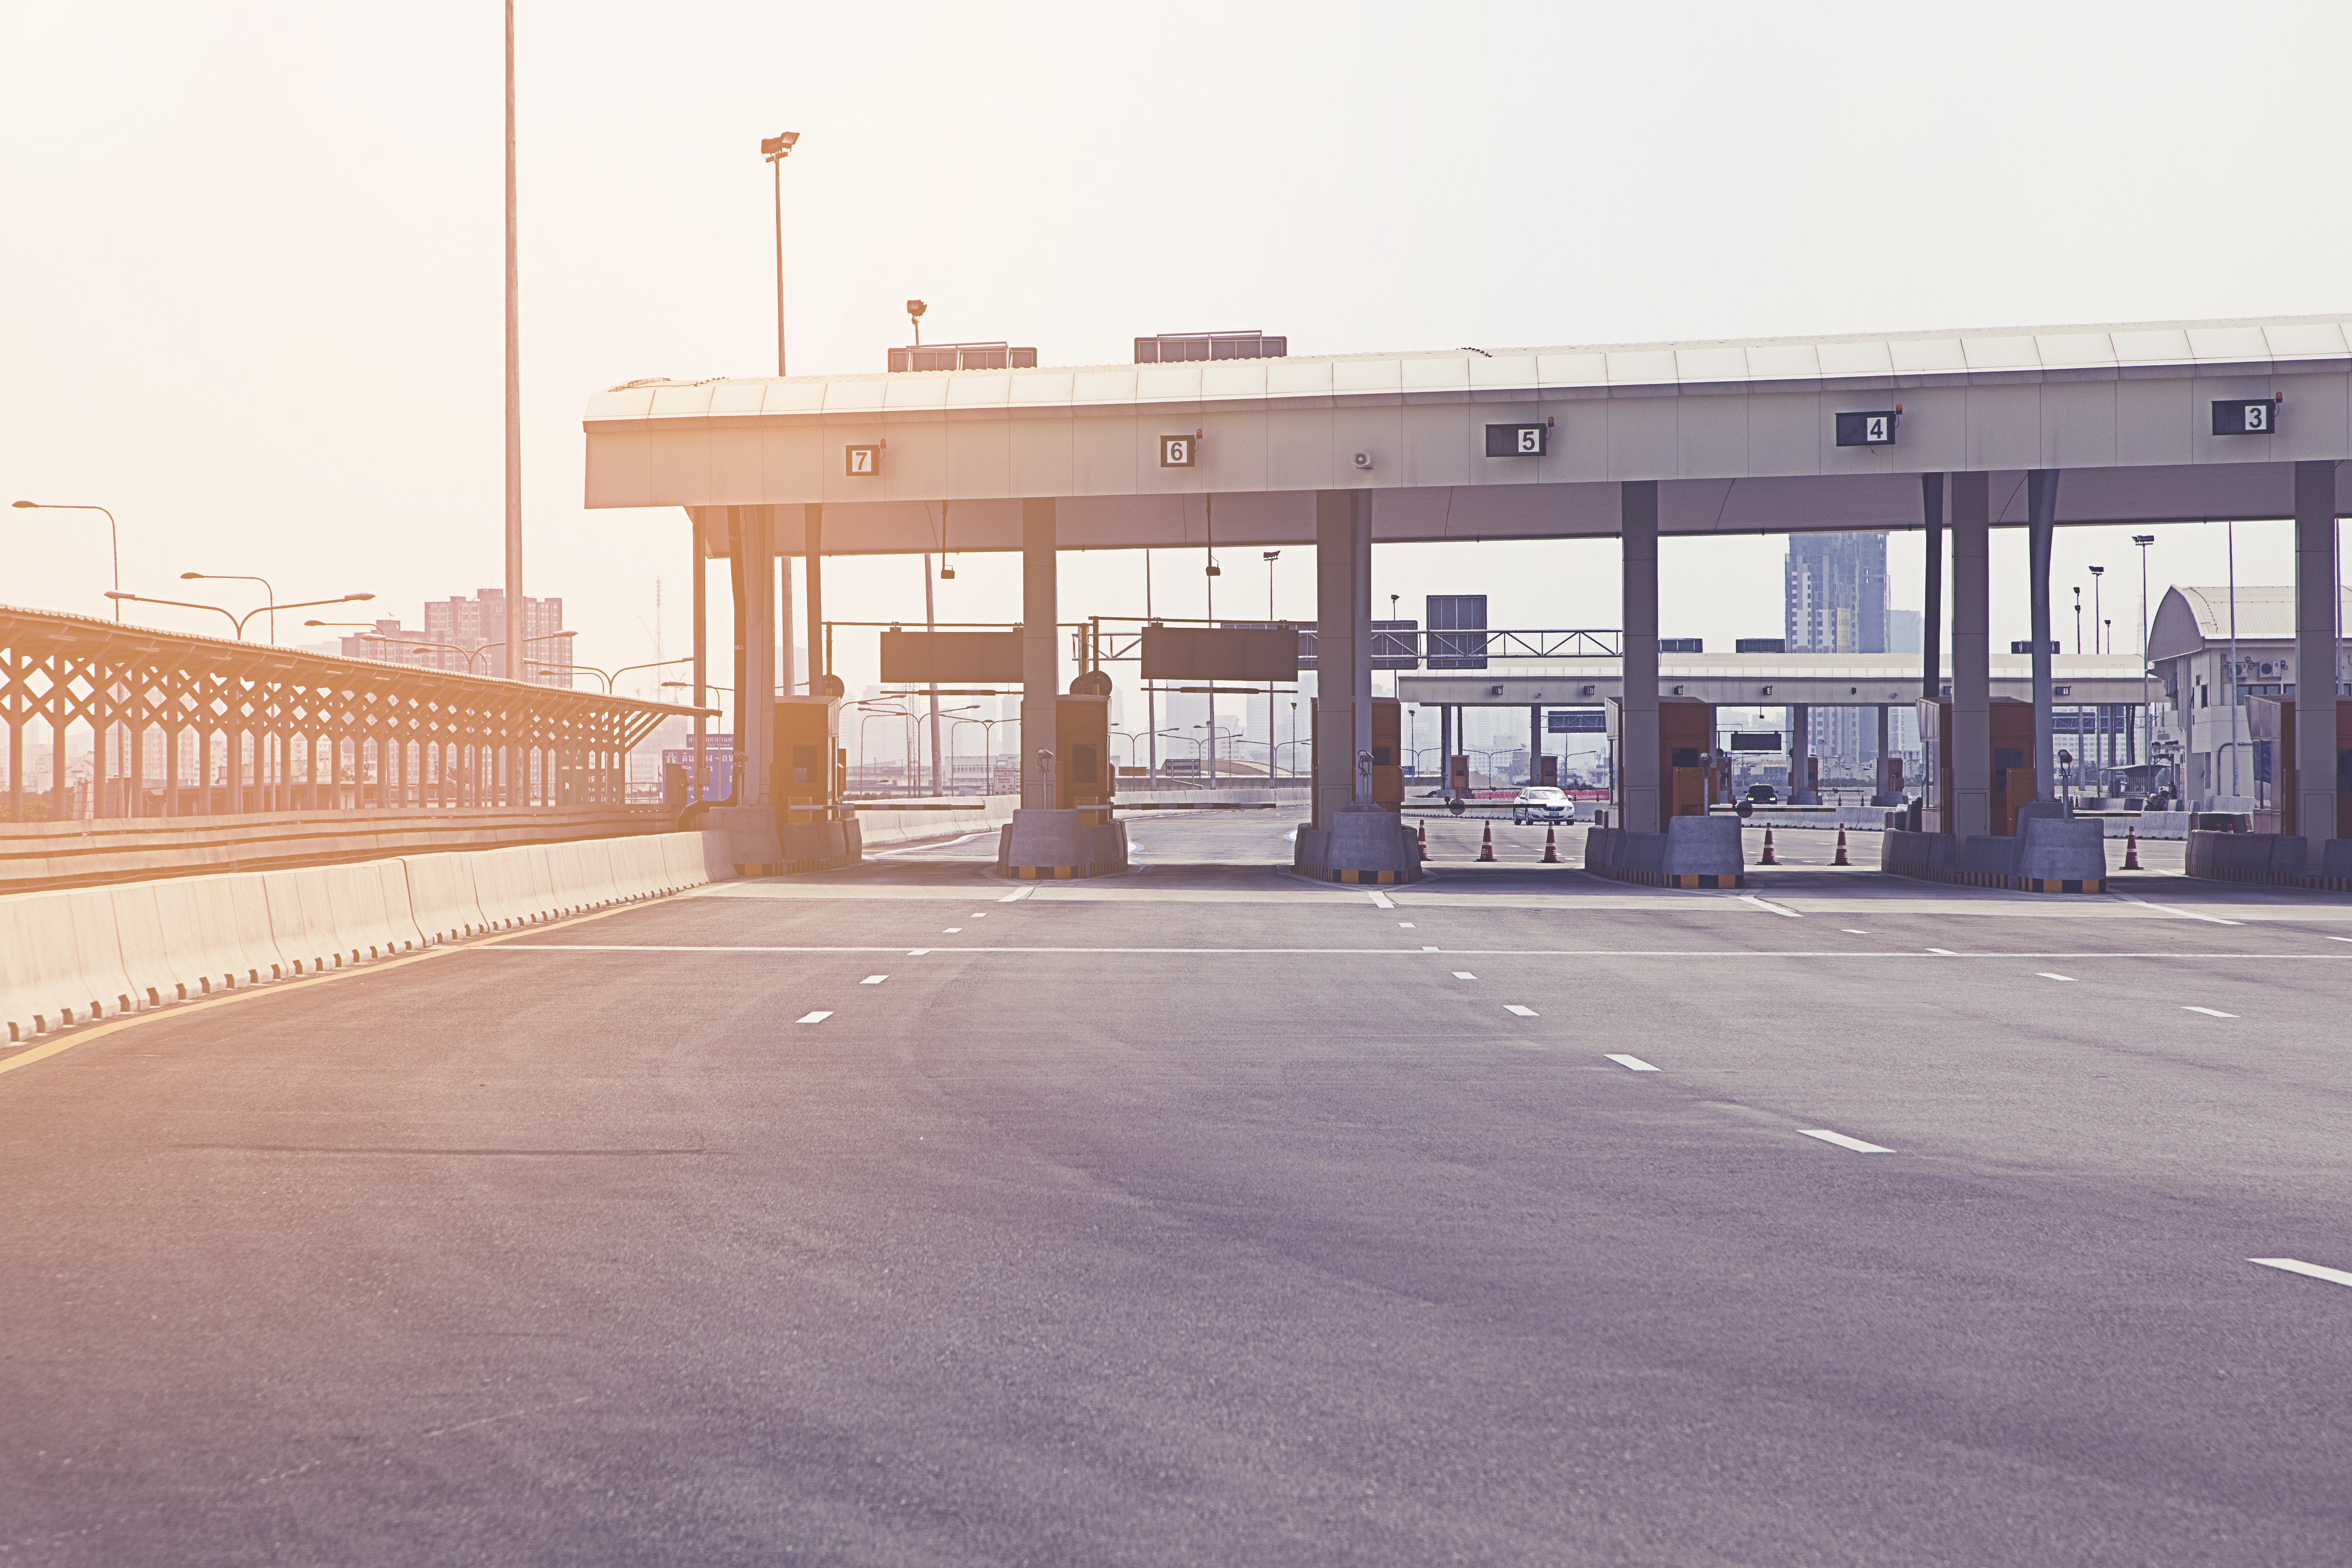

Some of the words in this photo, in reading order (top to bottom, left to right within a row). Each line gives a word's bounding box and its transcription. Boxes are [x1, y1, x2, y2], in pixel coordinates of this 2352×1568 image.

[2249, 407, 2262, 428] 3
[1870, 419, 1883, 438] 4
[1523, 431, 1535, 450] 5
[856, 452, 867, 470] 7
[1171, 442, 1183, 461] 6
